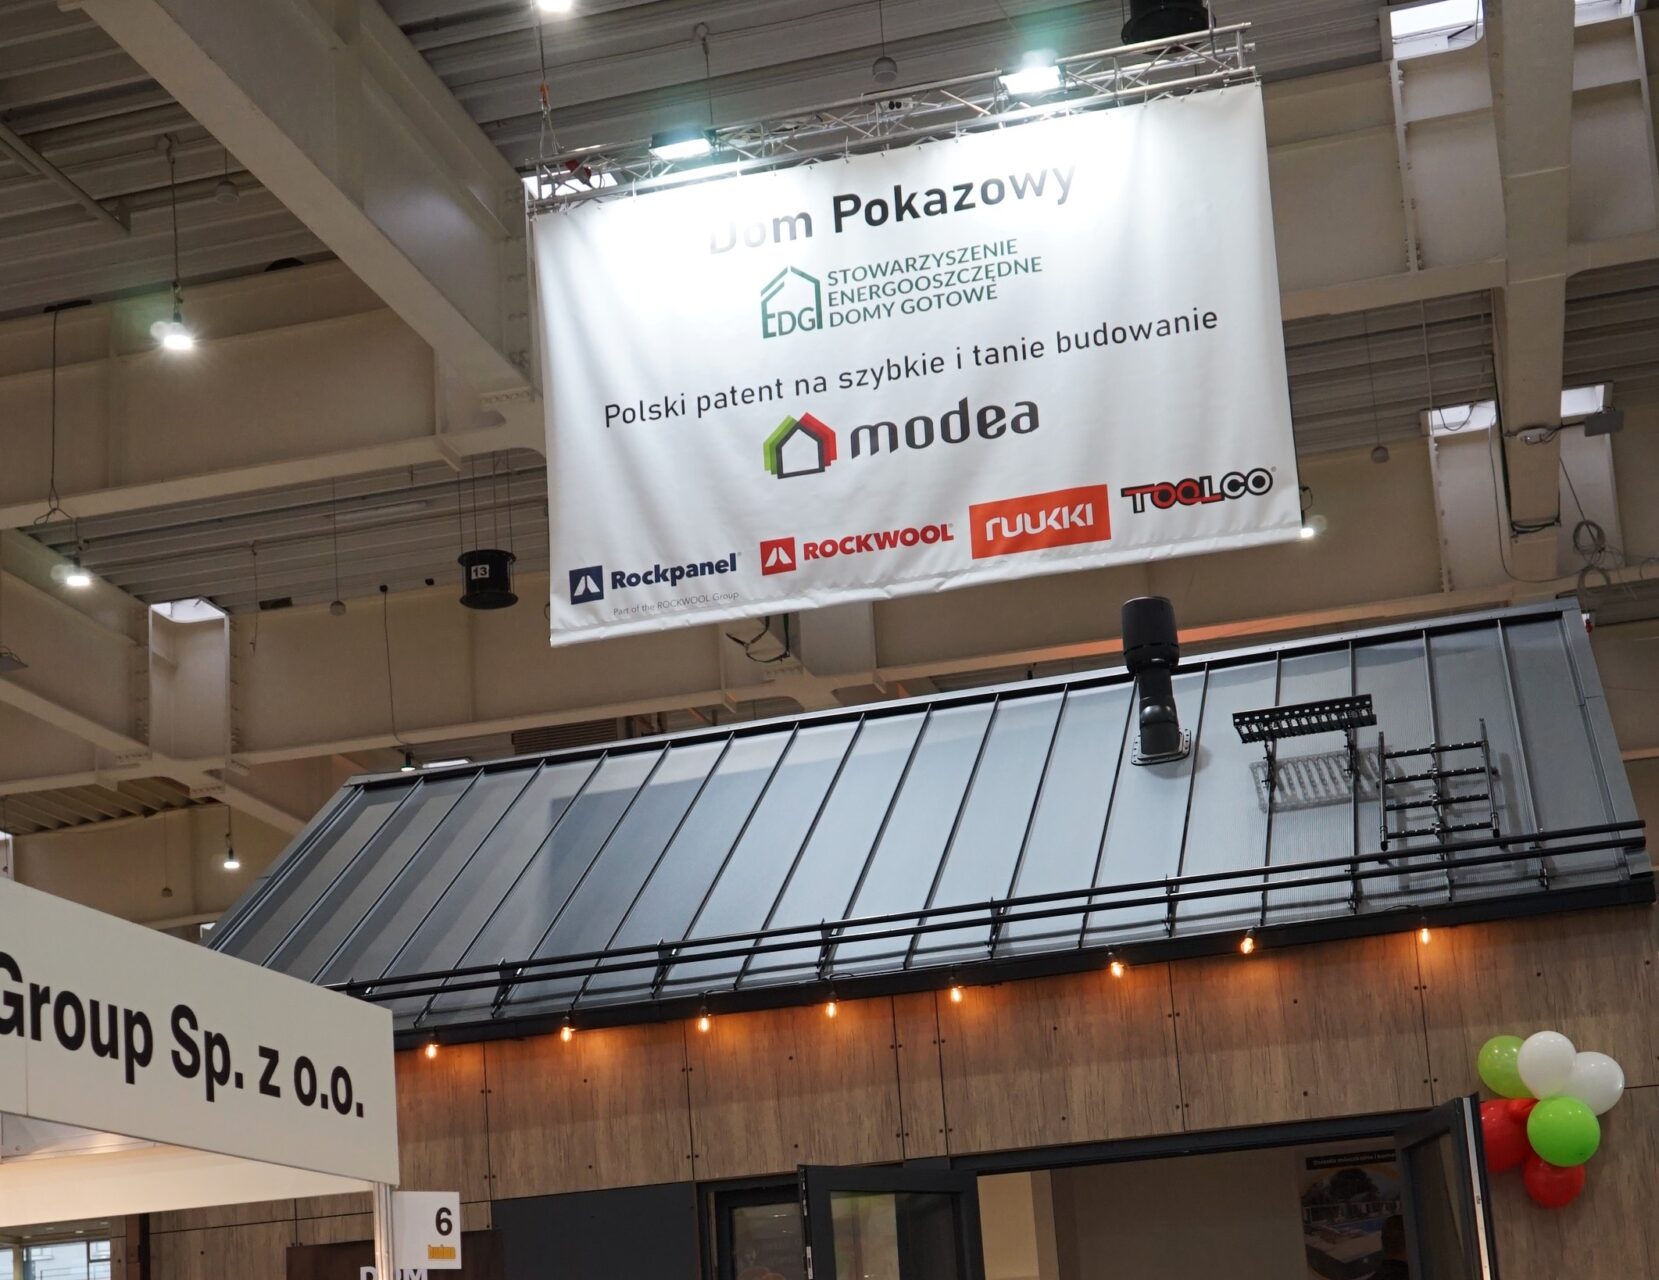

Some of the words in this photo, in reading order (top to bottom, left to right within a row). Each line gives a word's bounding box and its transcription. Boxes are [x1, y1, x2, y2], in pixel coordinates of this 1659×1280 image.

[709, 210, 813, 254] Dom
[832, 164, 1077, 233] Pokazowy
[827, 238, 1019, 286] STOWARZYSZENIE
[828, 256, 1043, 307] ENERGOOSZCZĘDNE
[829, 302, 896, 328] DOMY
[900, 283, 999, 315] GOTOWE
[605, 393, 686, 428] Polski
[697, 378, 784, 418] patent
[794, 375, 828, 397] na
[839, 352, 945, 390] szybkie
[956, 346, 962, 369] i
[973, 337, 1045, 367] tanie
[1056, 307, 1218, 354] budowanie
[850, 396, 1040, 459] modea
[1120, 467, 1274, 514] TOOLCO
[803, 523, 954, 561] ROCKWOOL
[472, 566, 489, 578] 13
[611, 552, 738, 590] Rockpanel
[613, 606, 629, 616] Part
[657, 594, 709, 610] ROCKWOOL
[712, 591, 740, 602] Group
[0, 953, 154, 1085] Group
[170, 1004, 244, 1103] Sp.
[258, 1045, 281, 1099] z
[293, 1055, 364, 1118] o.o.
[435, 1207, 453, 1236] 6
